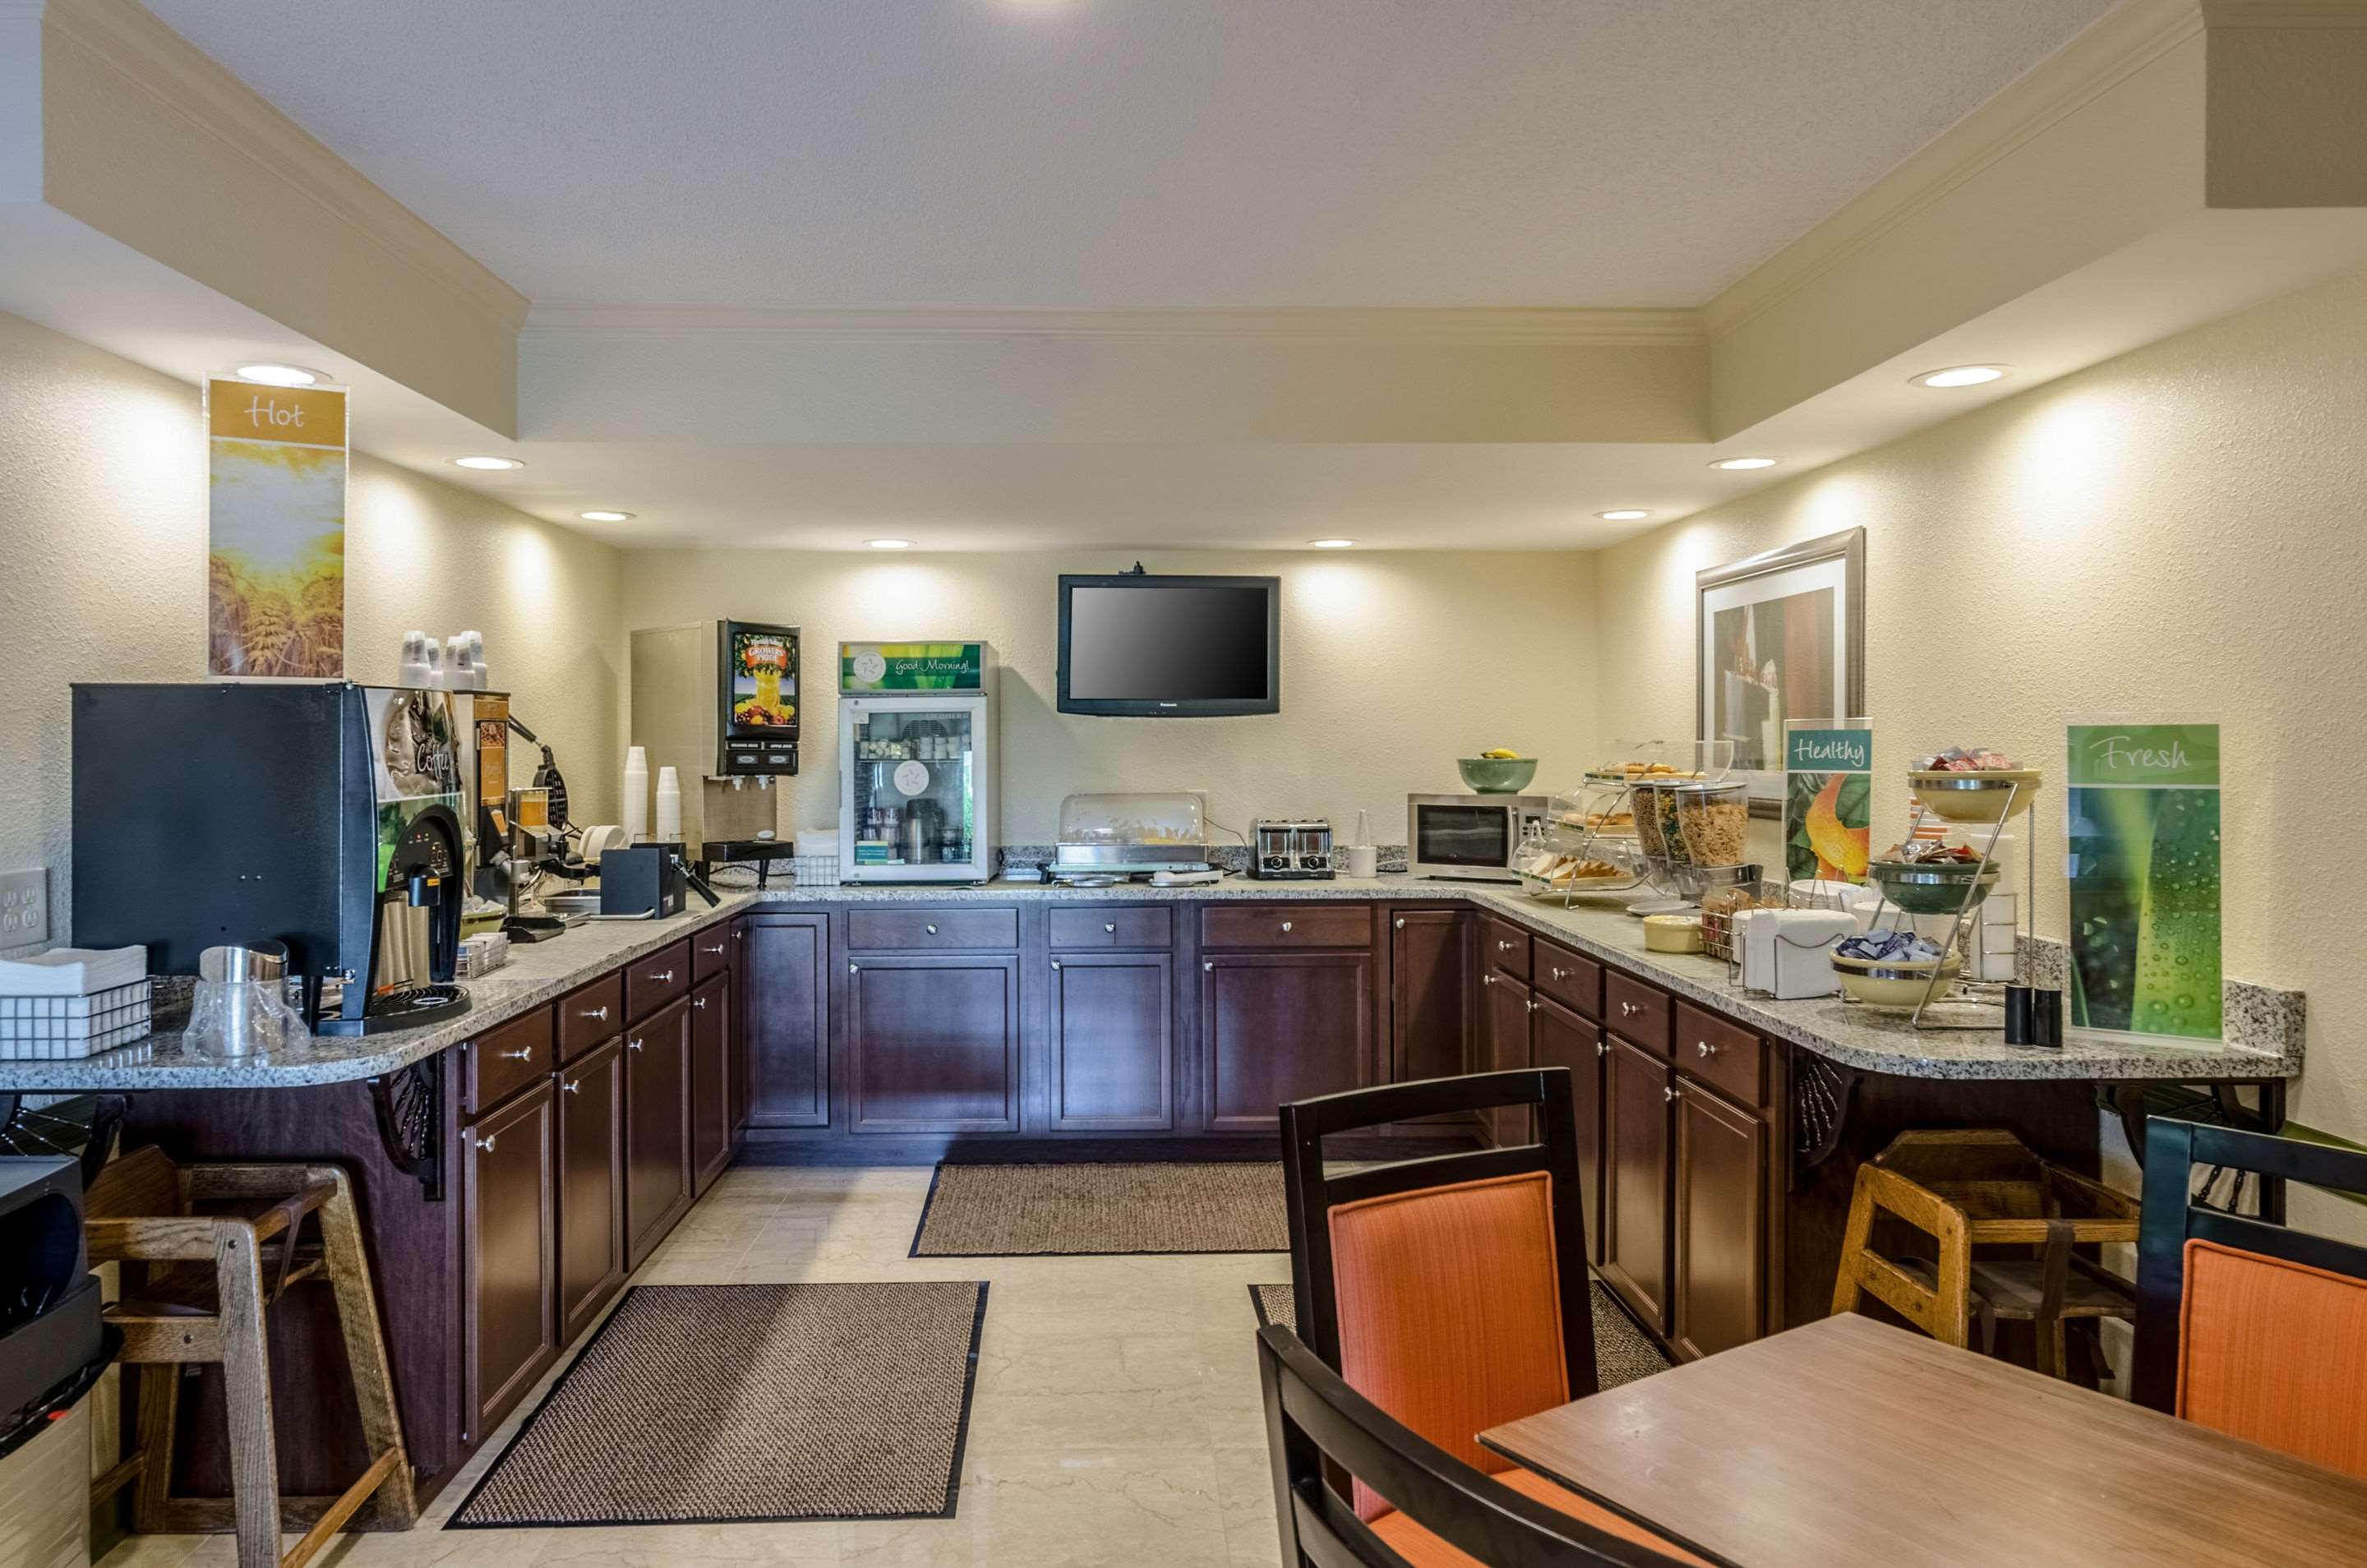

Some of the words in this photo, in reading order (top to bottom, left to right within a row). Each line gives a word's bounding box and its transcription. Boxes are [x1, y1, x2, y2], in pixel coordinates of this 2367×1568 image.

[243, 395, 305, 427] Hot
[895, 659, 919, 675] Good
[920, 659, 969, 674] Morning!
[1794, 739, 1864, 767] Healthy
[2088, 736, 2190, 769] Fresh
